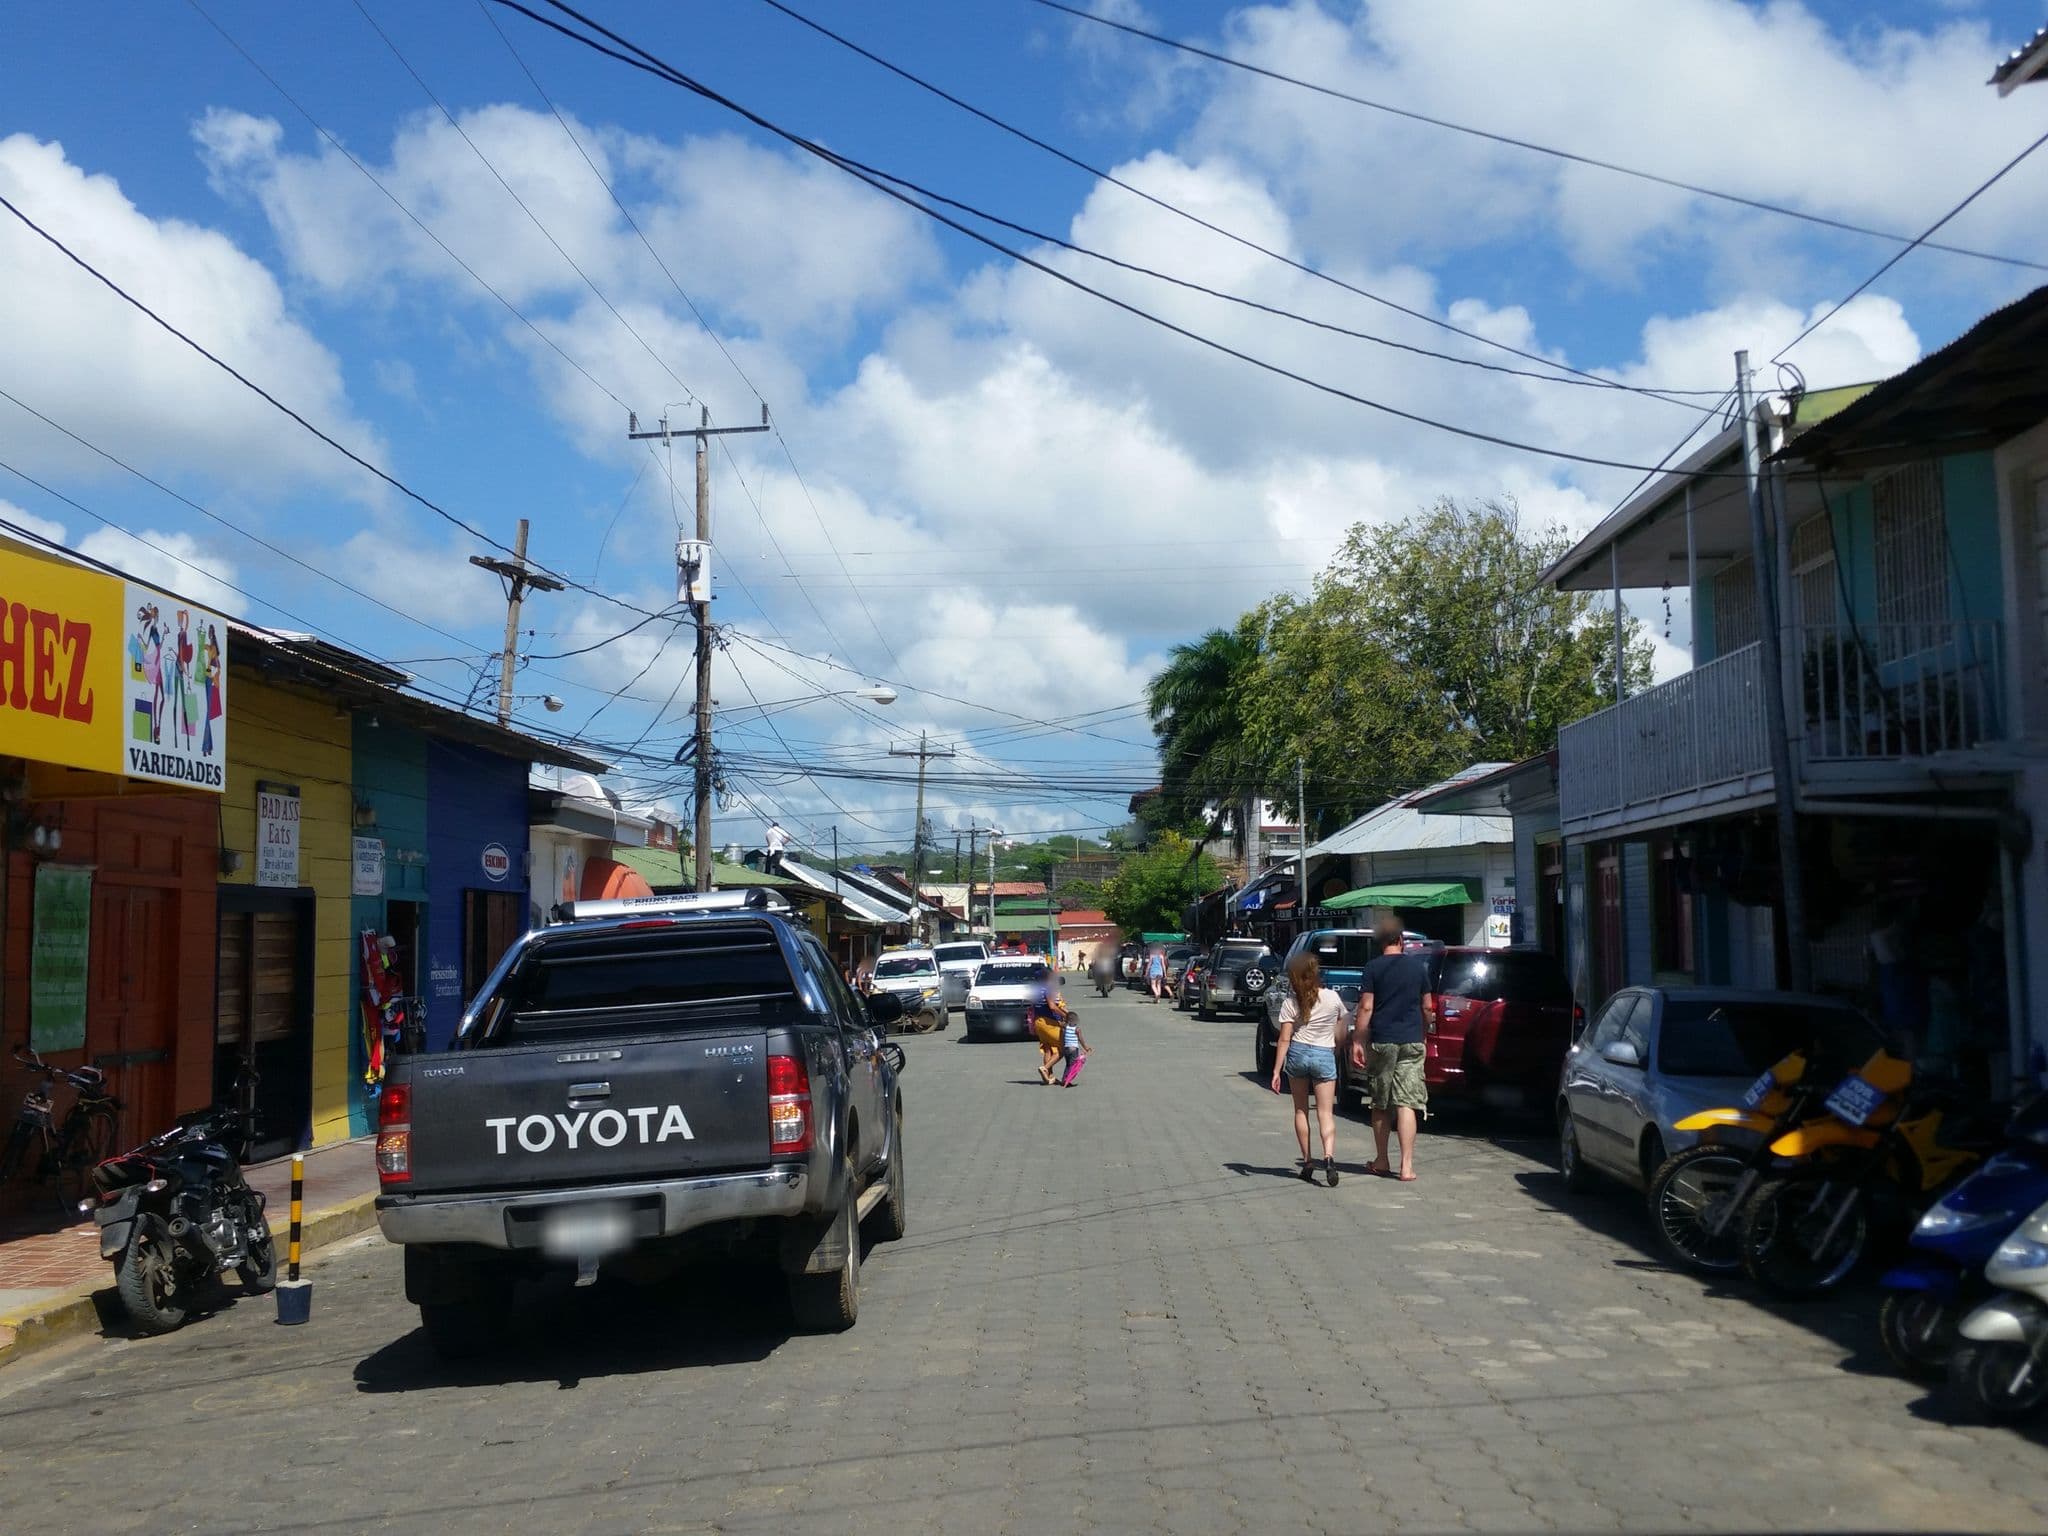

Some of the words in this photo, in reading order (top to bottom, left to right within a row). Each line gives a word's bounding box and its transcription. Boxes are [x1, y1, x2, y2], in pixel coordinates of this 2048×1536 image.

[129, 748, 222, 786] VARIEDADES
[261, 797, 280, 820] BAD
[281, 801, 300, 821] ASS
[268, 823, 291, 845] Eats
[485, 854, 507, 870] ESKIMO
[422, 1066, 465, 1078] TOYOTA
[704, 1044, 754, 1057] HILUX
[485, 1104, 695, 1154] TOYOTA
